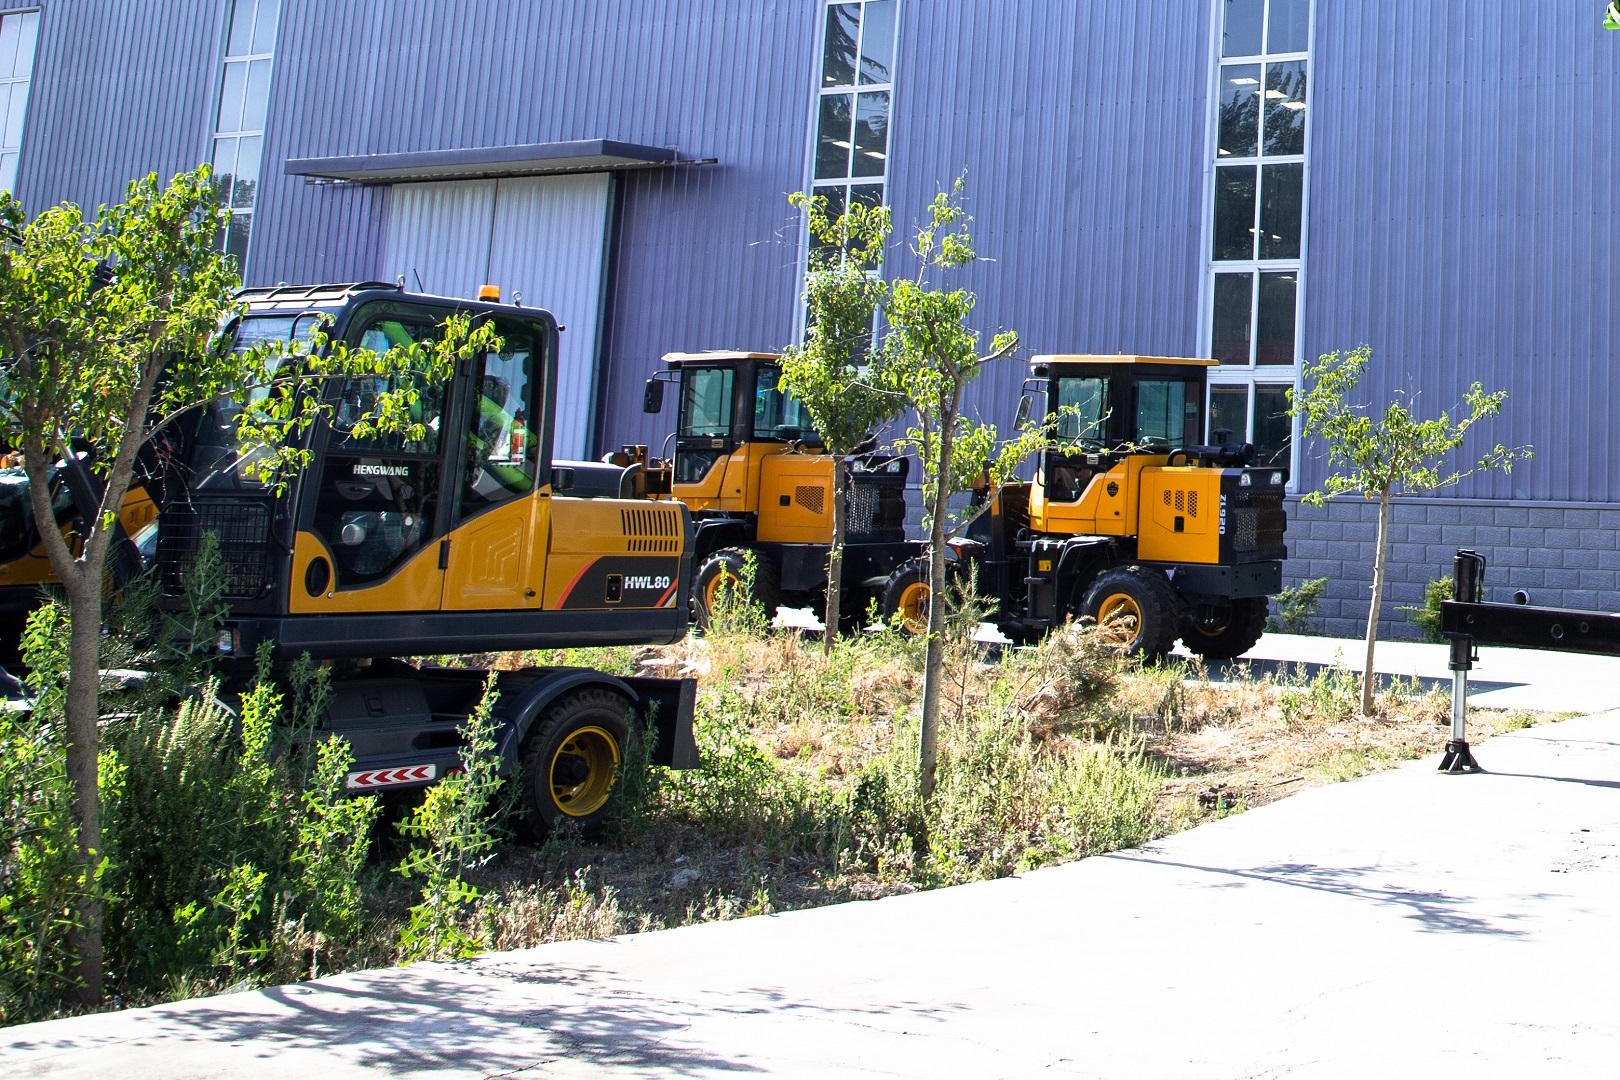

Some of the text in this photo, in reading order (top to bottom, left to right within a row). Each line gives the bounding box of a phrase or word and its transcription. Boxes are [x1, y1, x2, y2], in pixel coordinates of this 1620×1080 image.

[353, 463, 408, 476] HENGWANG
[1218, 494, 1228, 535] ZL920
[624, 573, 670, 589] HWL80
